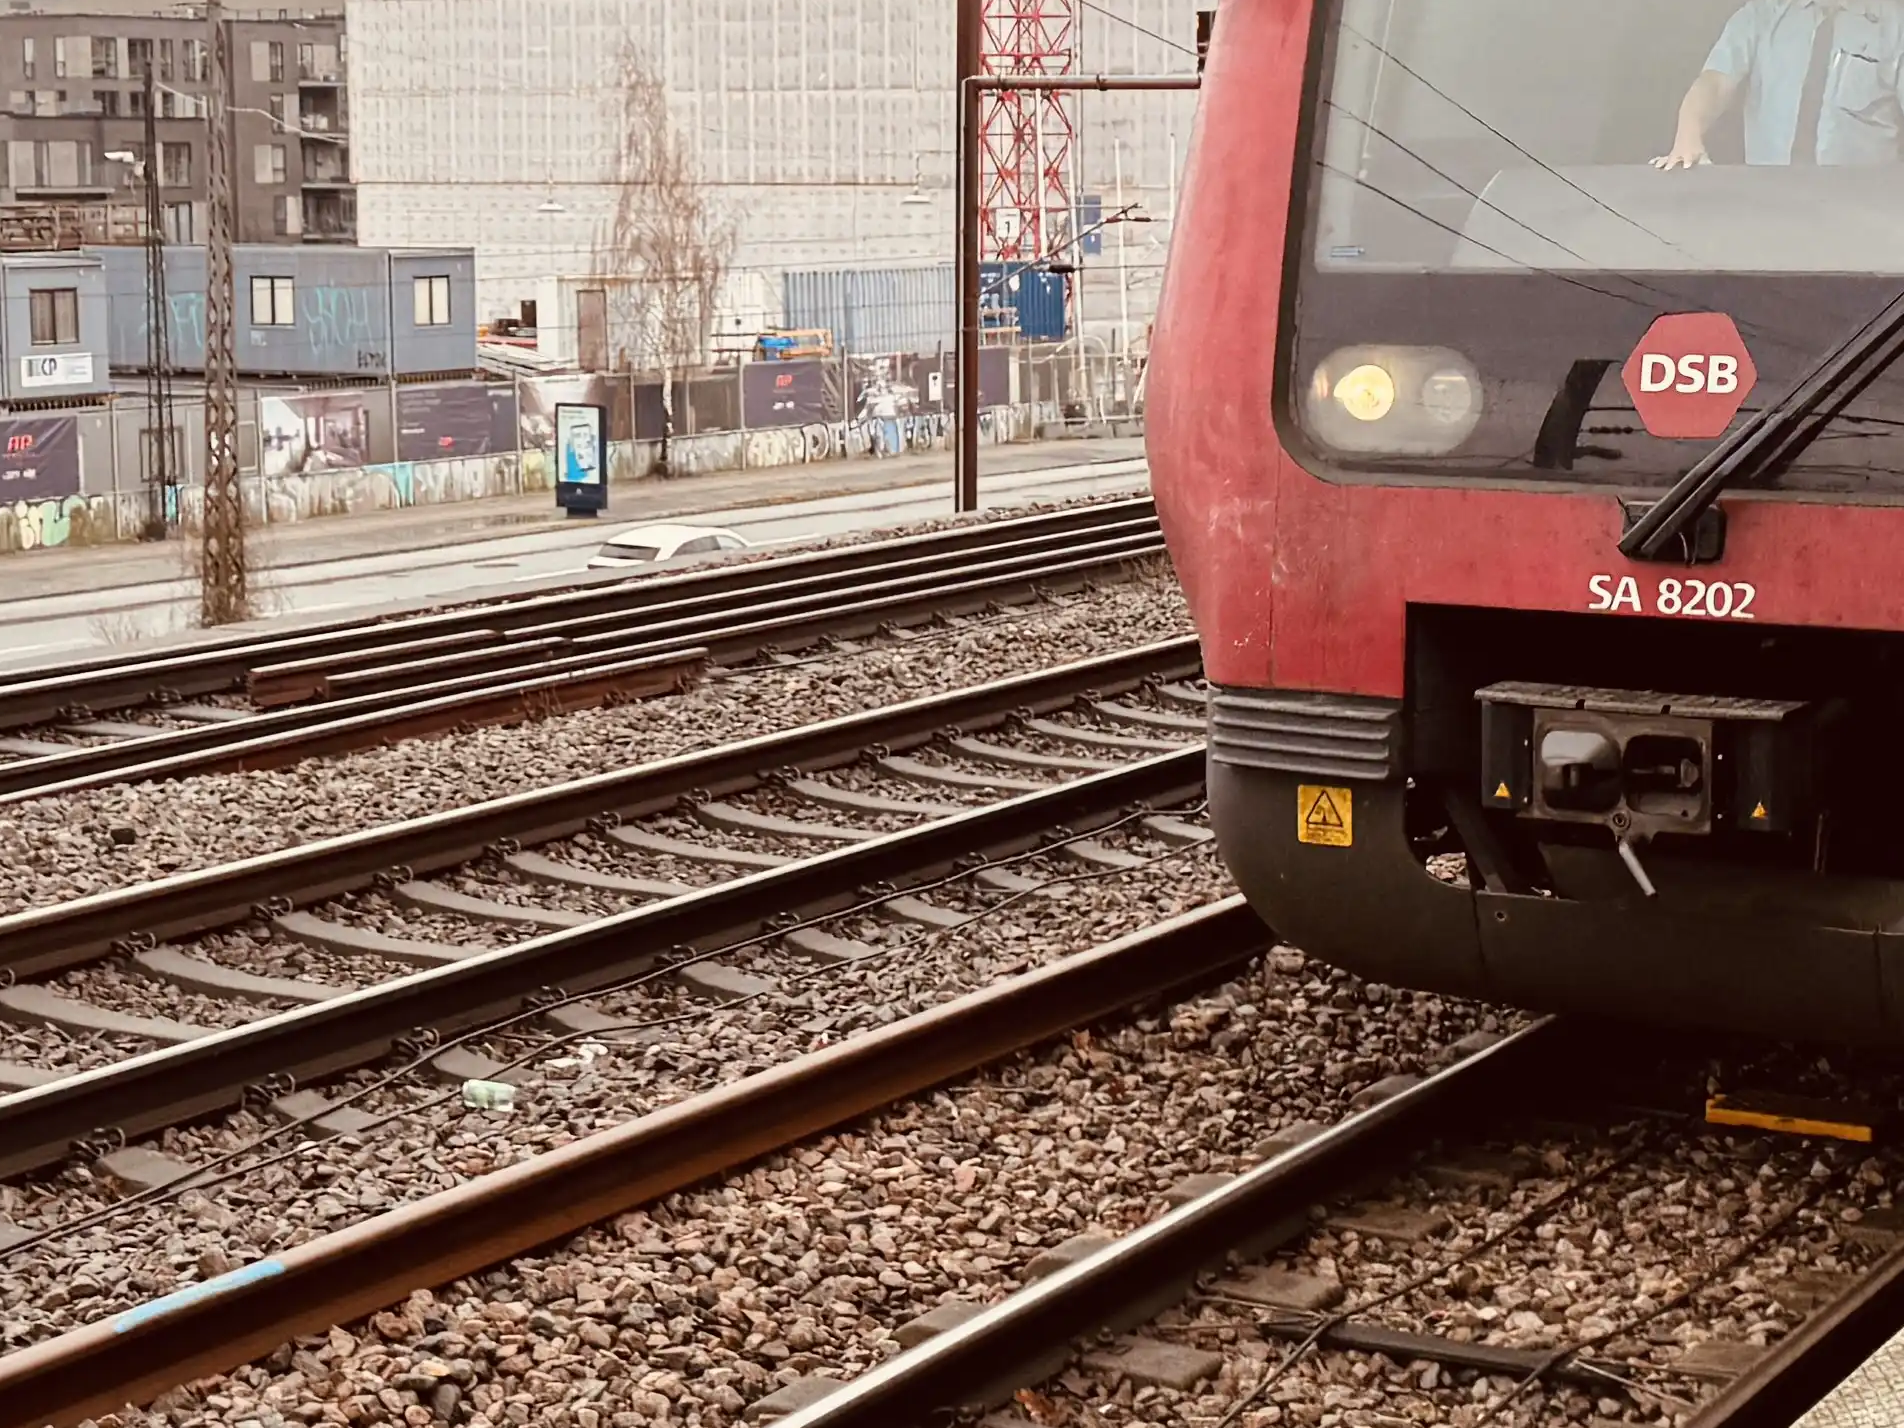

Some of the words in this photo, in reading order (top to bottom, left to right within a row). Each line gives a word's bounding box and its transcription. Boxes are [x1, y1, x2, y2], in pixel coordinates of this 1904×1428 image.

[1639, 353, 1739, 394] DSB
[1588, 574, 1642, 611] SA
[1657, 578, 1755, 619] 8202
